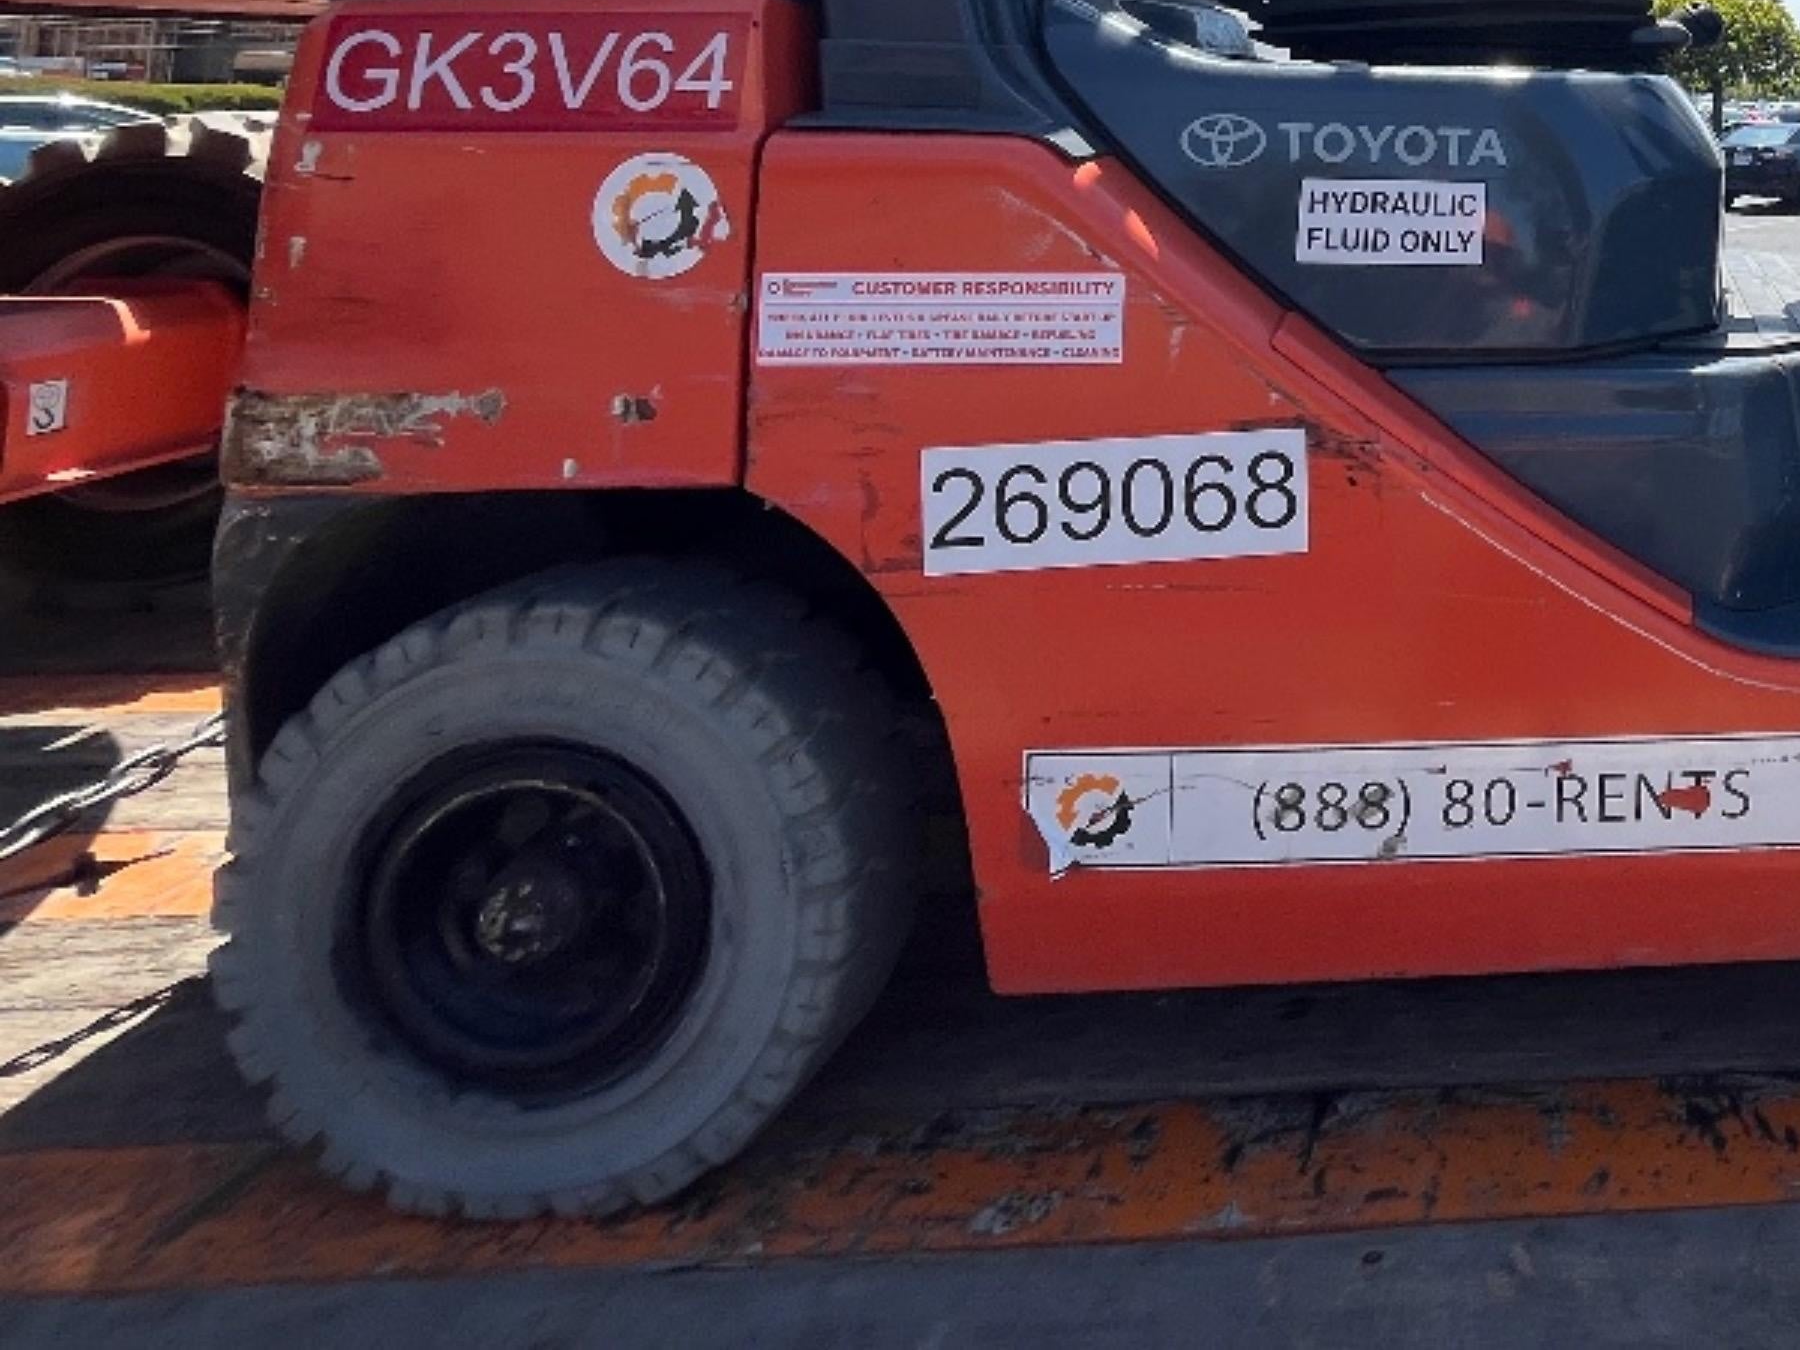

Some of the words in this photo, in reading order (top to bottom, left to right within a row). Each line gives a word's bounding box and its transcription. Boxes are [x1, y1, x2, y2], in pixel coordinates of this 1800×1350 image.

[325, 29, 733, 112] GK3V64
[1277, 122, 1507, 166] TOYOTA
[1307, 191, 1478, 217] HYDRAULIC
[1307, 227, 1390, 252] FLUID
[1400, 230, 1475, 254] ONLY
[852, 281, 955, 295] CUSTOMER
[963, 281, 1115, 295] RESPONSIBILITY
[930, 451, 1297, 549] 269068
[1254, 776, 1411, 840] (888)
[1442, 770, 1751, 827] 80-RENTS
